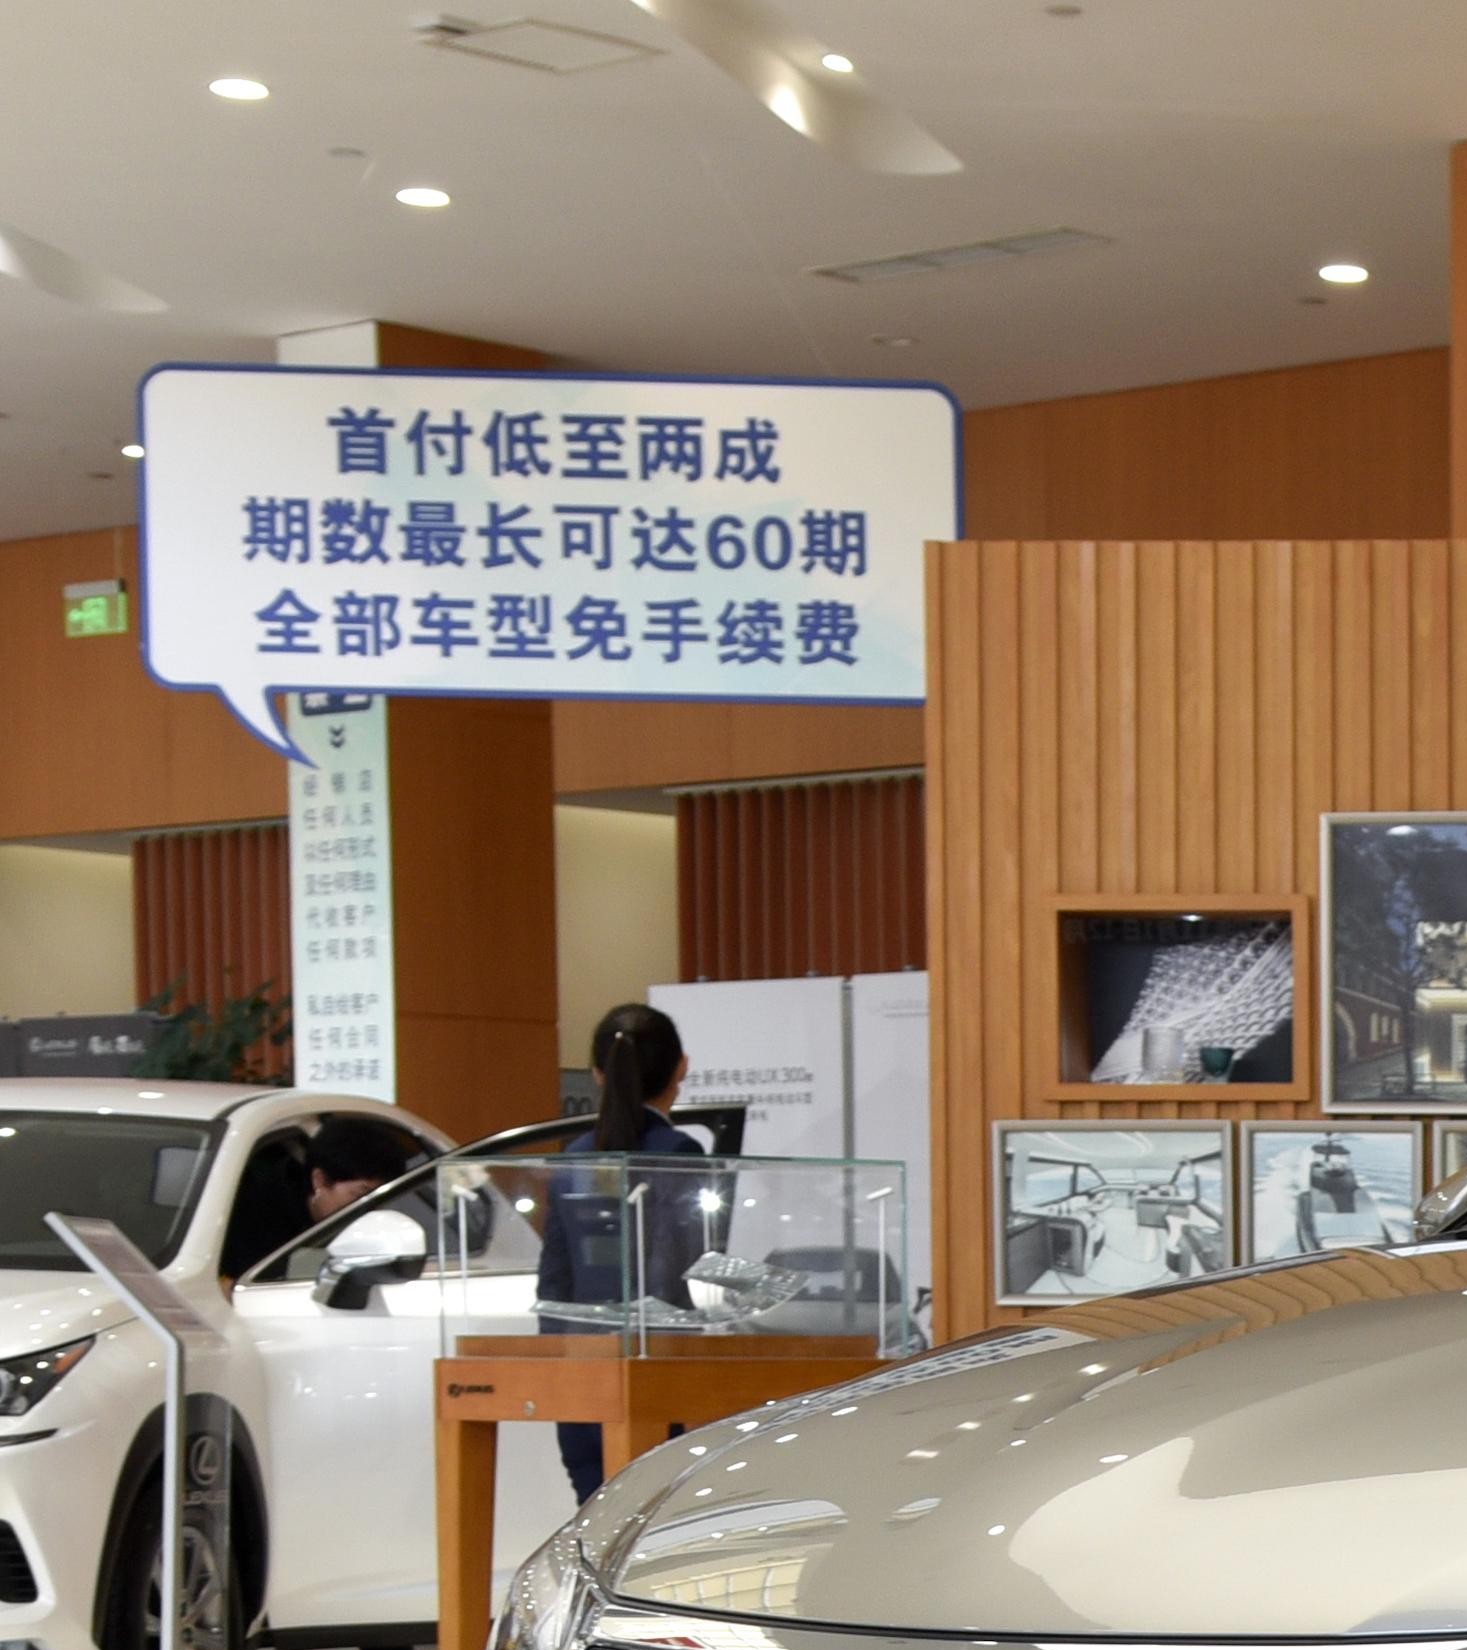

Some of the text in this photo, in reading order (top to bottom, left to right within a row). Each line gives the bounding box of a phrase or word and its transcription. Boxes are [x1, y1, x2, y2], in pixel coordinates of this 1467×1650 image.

[327, 407, 781, 483] 首付低至两成
[243, 497, 868, 577] 期数最长可达60期
[256, 588, 860, 667] 全部车型免手续费
